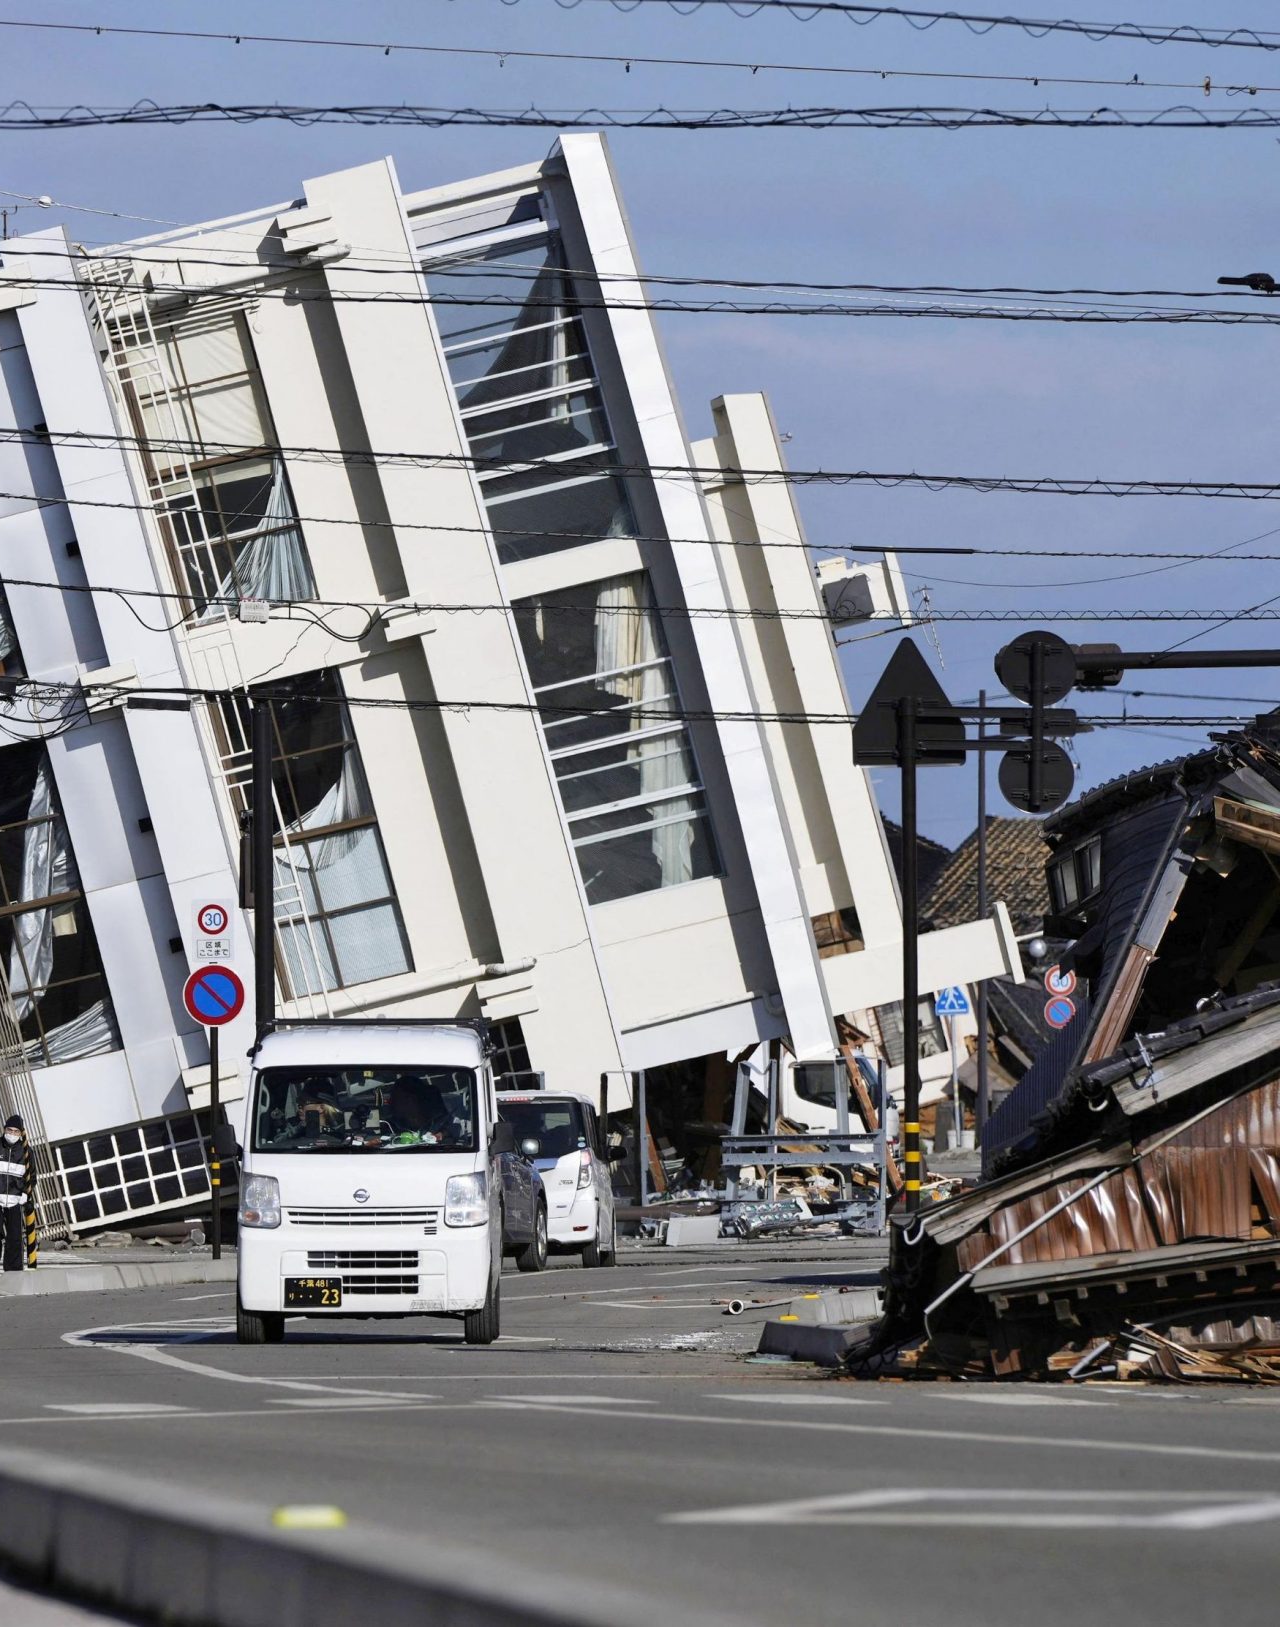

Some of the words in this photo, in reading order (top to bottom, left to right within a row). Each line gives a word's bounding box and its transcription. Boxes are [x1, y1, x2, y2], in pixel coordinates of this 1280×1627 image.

[205, 912, 222, 926] 30
[205, 941, 221, 949] 区域
[1051, 974, 1070, 988] 30
[298, 1279, 314, 1288] 千葉
[315, 1279, 328, 1288] 481
[321, 1289, 339, 1304] 23
